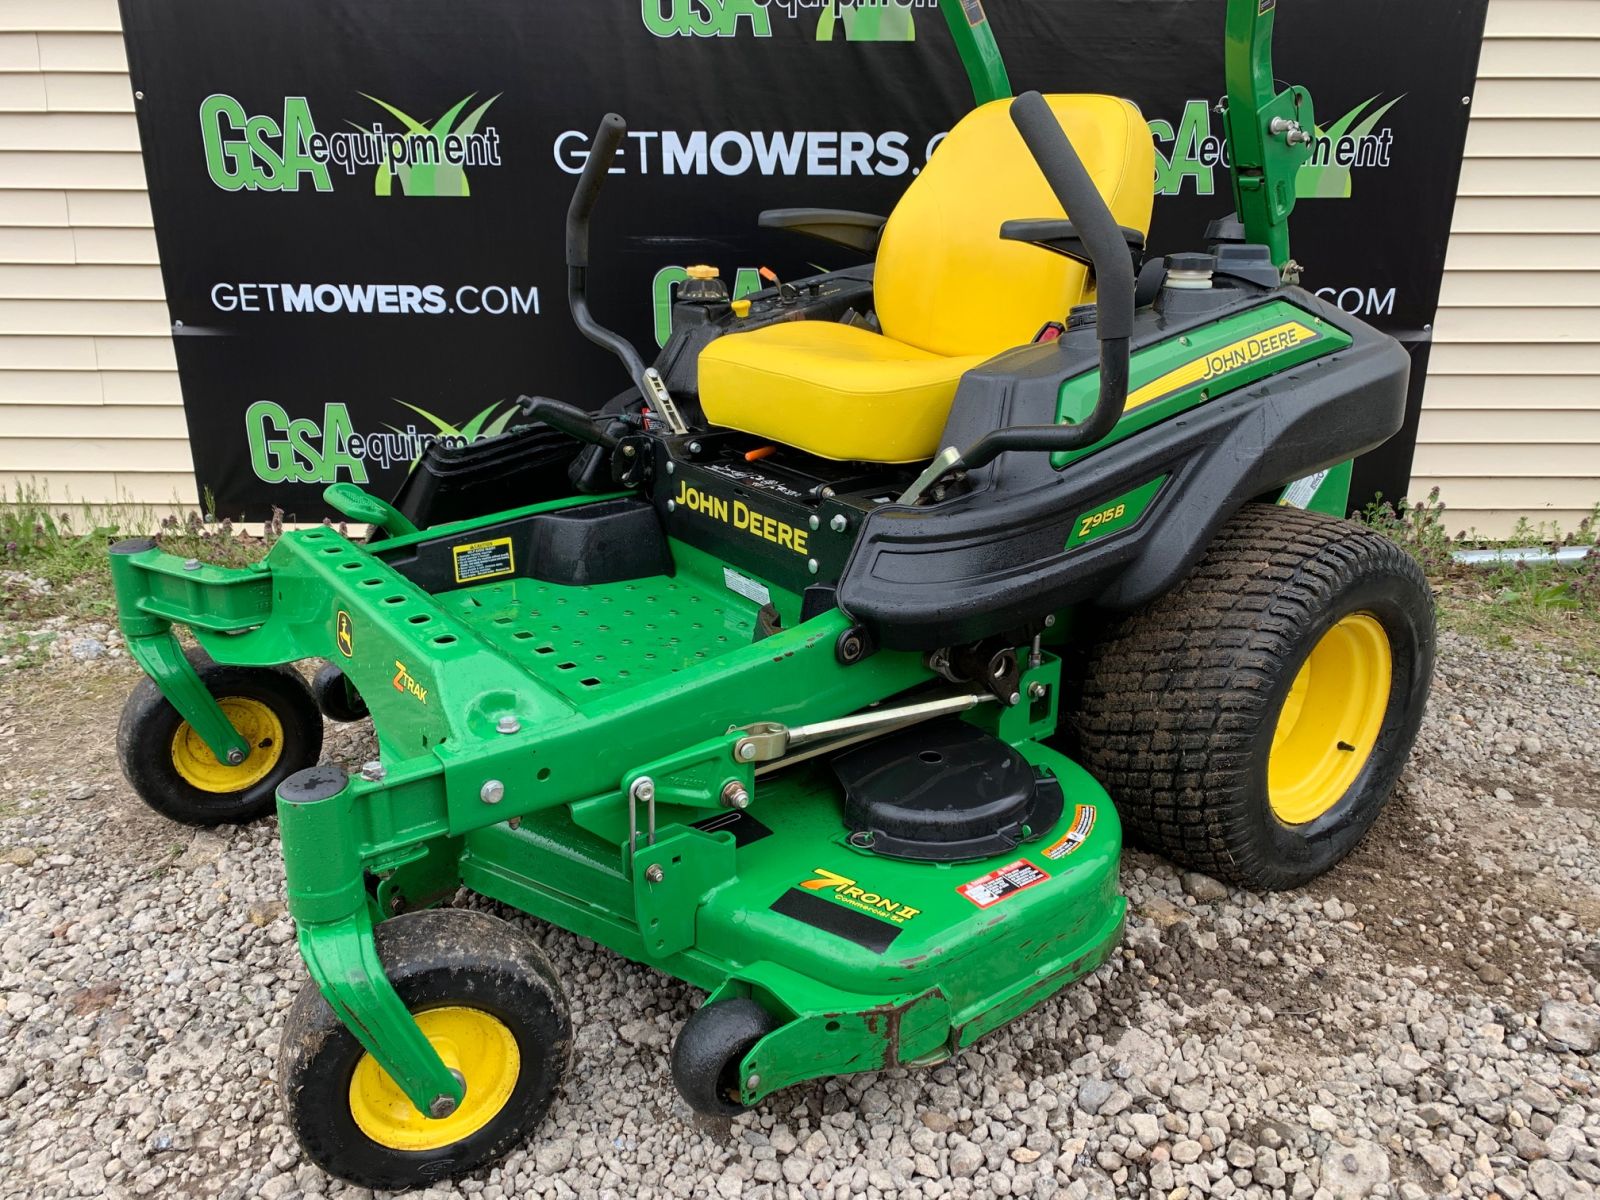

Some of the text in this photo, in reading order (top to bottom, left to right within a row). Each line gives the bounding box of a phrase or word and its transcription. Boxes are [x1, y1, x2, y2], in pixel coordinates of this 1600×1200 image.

[308, 123, 501, 174] equipment
[211, 283, 540, 314] GETMOWERS.COM
[1203, 328, 1299, 378] JOHN DEERE
[676, 480, 728, 523] JOHN
[733, 500, 808, 555] DEERE
